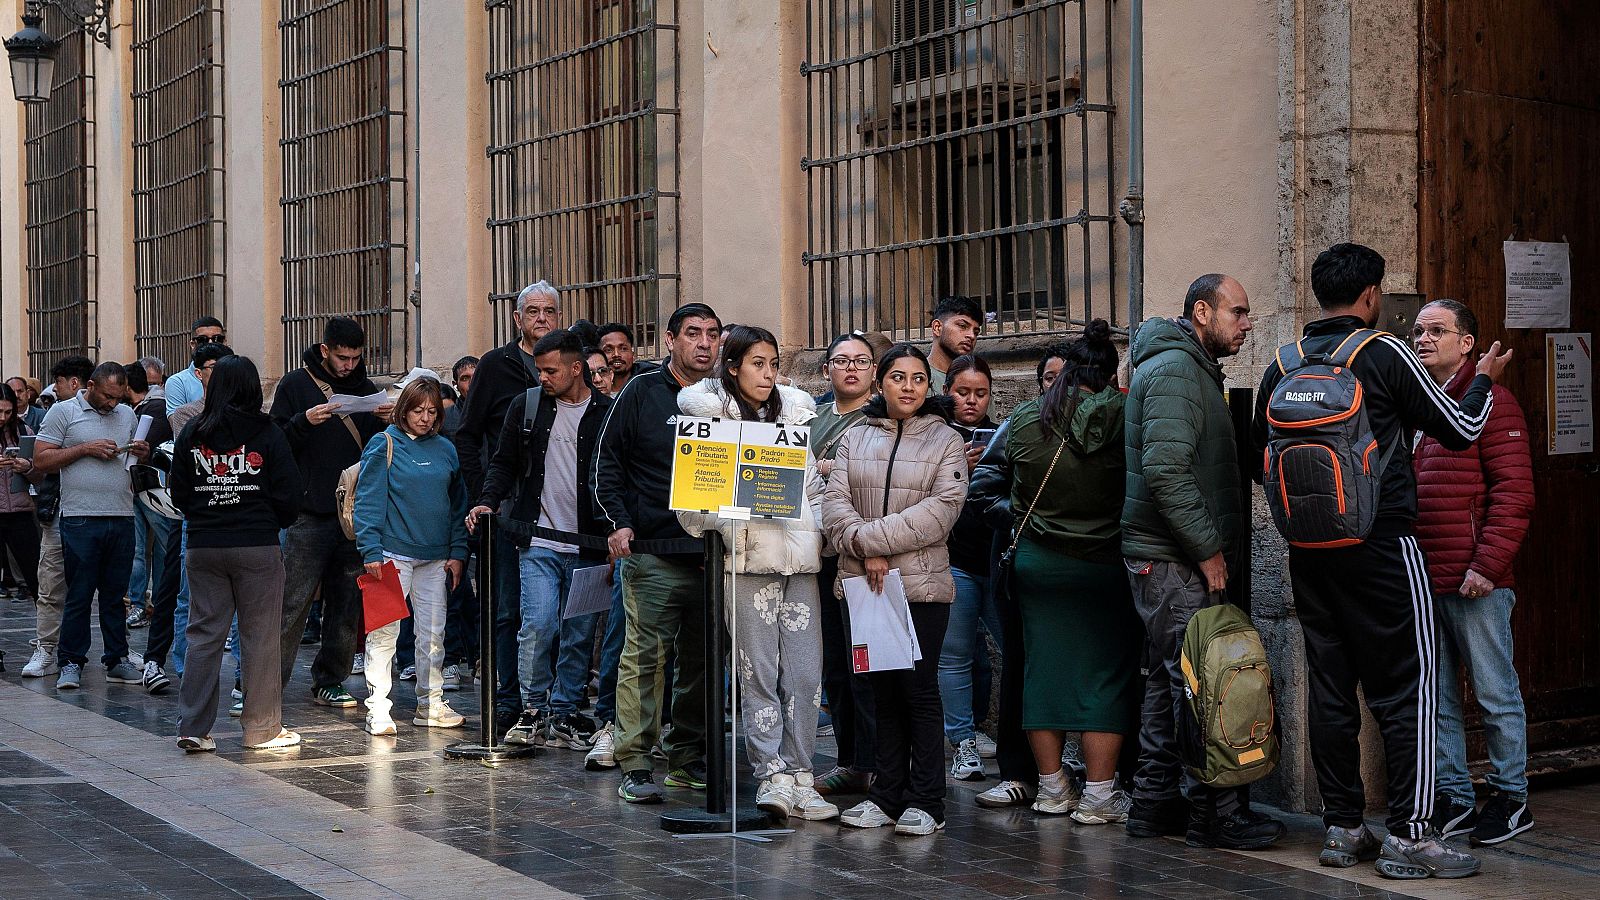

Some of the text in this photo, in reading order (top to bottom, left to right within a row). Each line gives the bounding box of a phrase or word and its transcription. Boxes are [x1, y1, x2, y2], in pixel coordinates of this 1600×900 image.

[697, 422, 711, 438] B
[774, 430, 789, 445] A
[696, 444, 727, 453] Atención
[760, 449, 785, 457] Padrón
[696, 451, 729, 459] Tributaria
